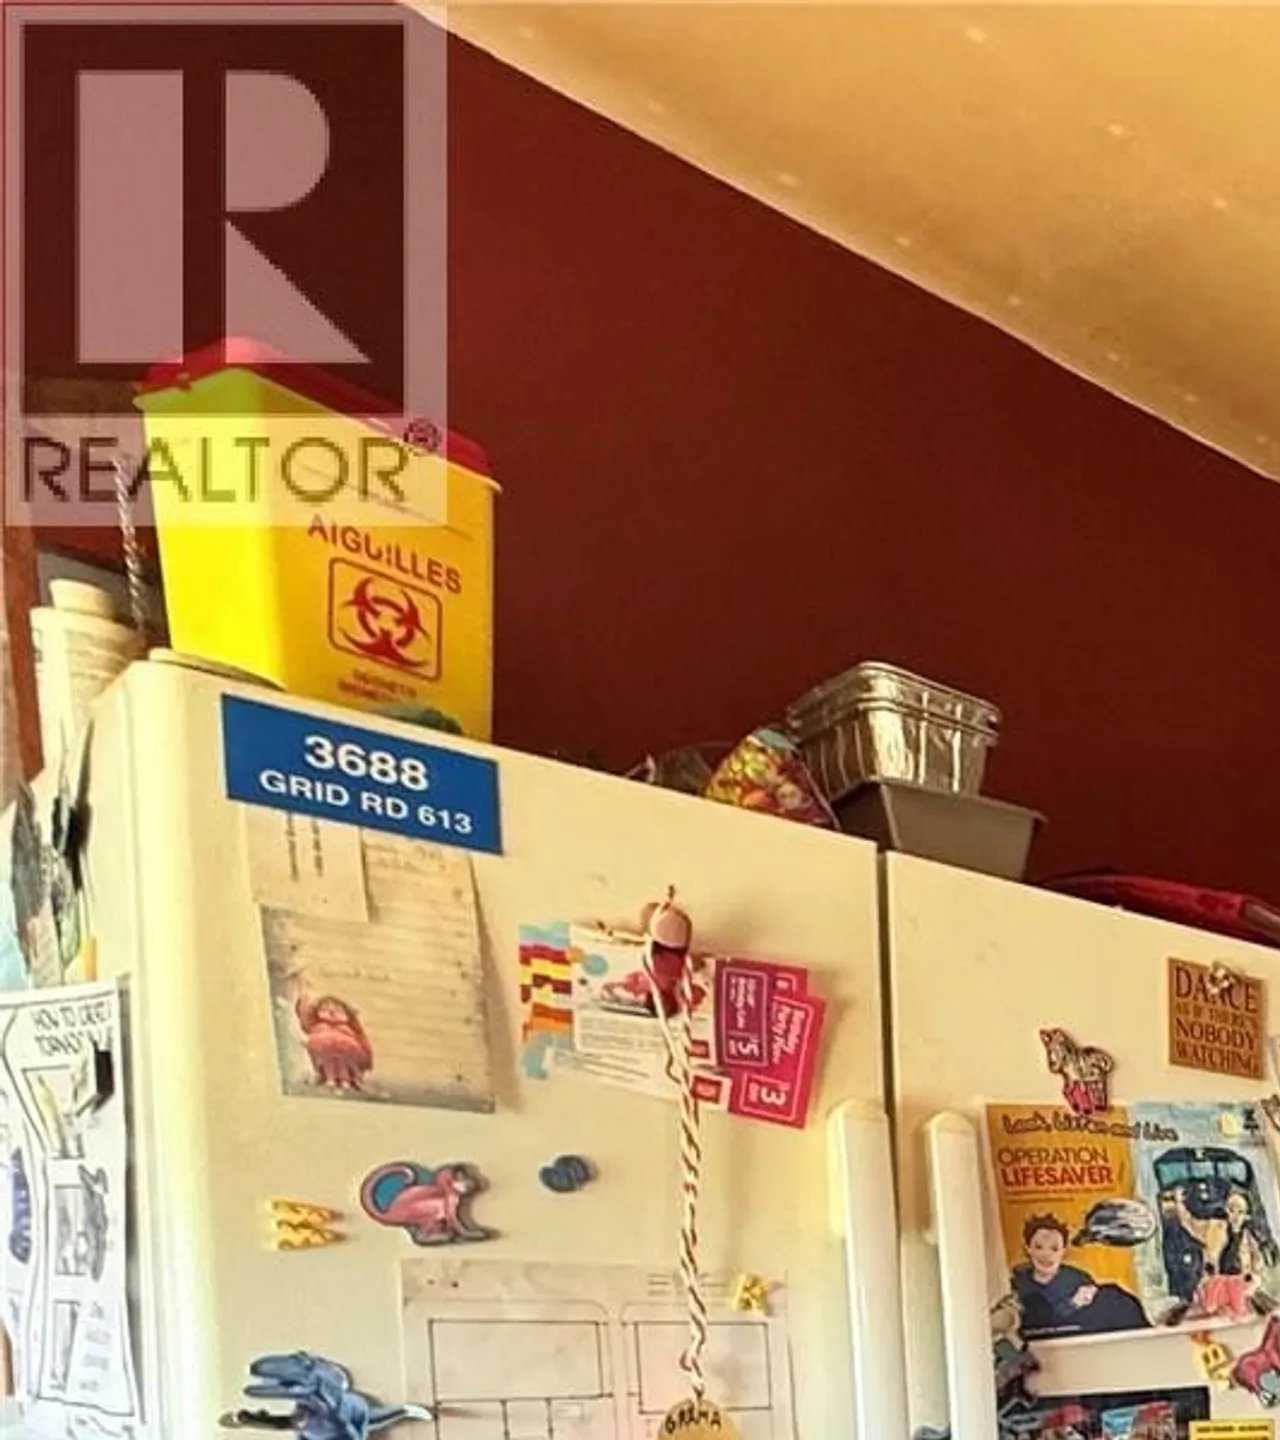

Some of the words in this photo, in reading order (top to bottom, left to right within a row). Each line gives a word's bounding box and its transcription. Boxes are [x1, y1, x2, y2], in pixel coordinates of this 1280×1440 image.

[308, 513, 462, 594] AIGUILLES
[304, 735, 429, 791] 3688
[259, 769, 349, 806] GRID
[360, 791, 409, 819] RD
[417, 806, 473, 833] 613
[1176, 1017, 1254, 1052] NOBODY
[1176, 1041, 1259, 1075] WATCHING
[998, 1147, 1109, 1165] OPERATION
[1001, 1165, 1113, 1187] LIFESAVER
